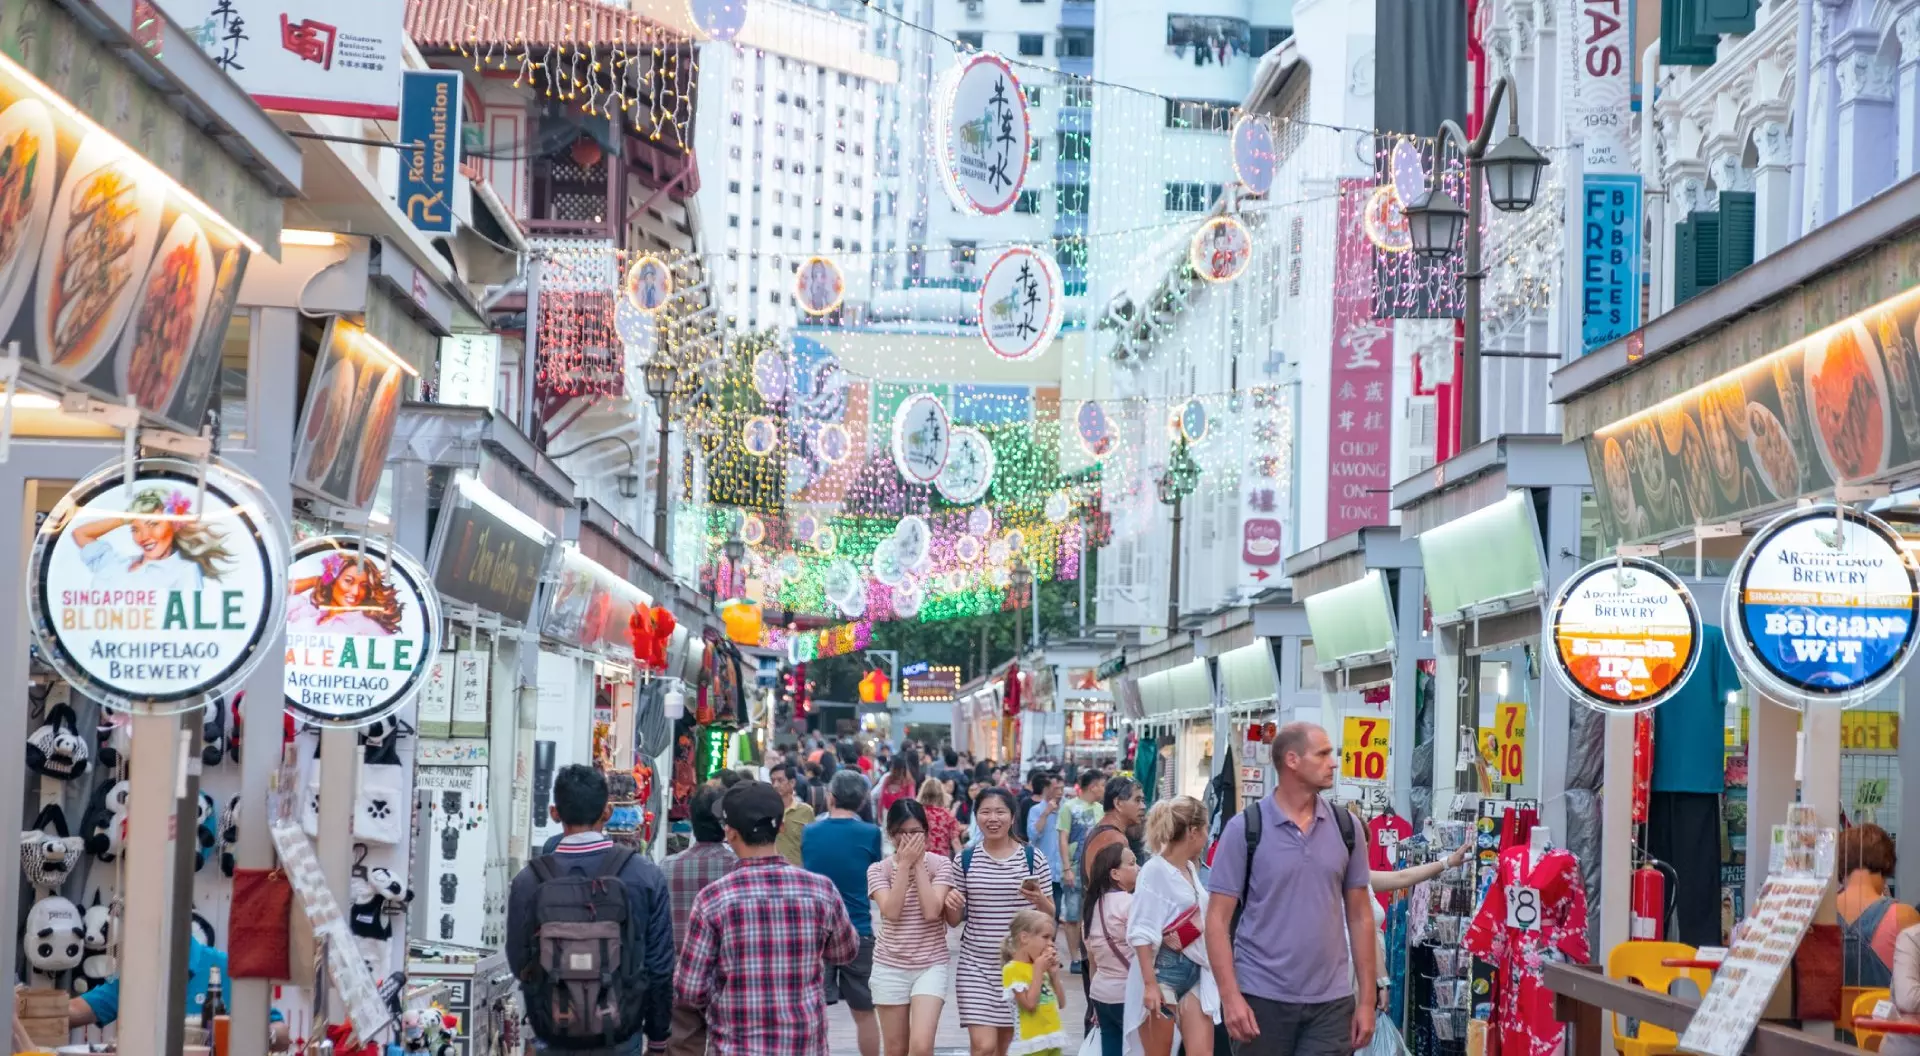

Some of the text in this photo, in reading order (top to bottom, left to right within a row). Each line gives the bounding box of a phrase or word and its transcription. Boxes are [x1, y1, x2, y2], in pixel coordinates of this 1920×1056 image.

[338, 33, 383, 44] Chinatown
[338, 41, 375, 51] Business
[338, 49, 387, 60] Association
[1584, 114, 1618, 127] 1993
[429, 82, 449, 183] revolution
[1592, 146, 1611, 154] UNIT
[960, 154, 988, 169] CHINATOWN
[960, 166, 986, 182] SINGAPORE
[1585, 189, 1606, 316] FREE
[1610, 190, 1625, 325] BUBBLES
[1340, 441, 1379, 456] CHOP
[1332, 461, 1387, 477] KWONG
[1340, 504, 1379, 520] TONG
[1793, 567, 1868, 584] BREWERY
[62, 590, 157, 606] SINGAPORE
[62, 590, 246, 631] BLONDE ALE
[1595, 604, 1656, 618] BREWERY
[90, 640, 219, 660] ARCHIPELAGO
[338, 637, 414, 671] ALE
[109, 661, 202, 680] BREWERY
[902, 661, 928, 675] MORE
[1599, 657, 1650, 678] IPA
[288, 671, 389, 690] ARCHIPELAGO
[1458, 677, 1469, 698] 2
[302, 688, 376, 707] BREWERY
[1505, 706, 1518, 739] 7
[1359, 720, 1388, 748] 7 FOR
[1345, 751, 1385, 780] $10
[1501, 743, 1523, 777] 10
[449, 779, 473, 789] NAME
[1488, 802, 1496, 816] 7
